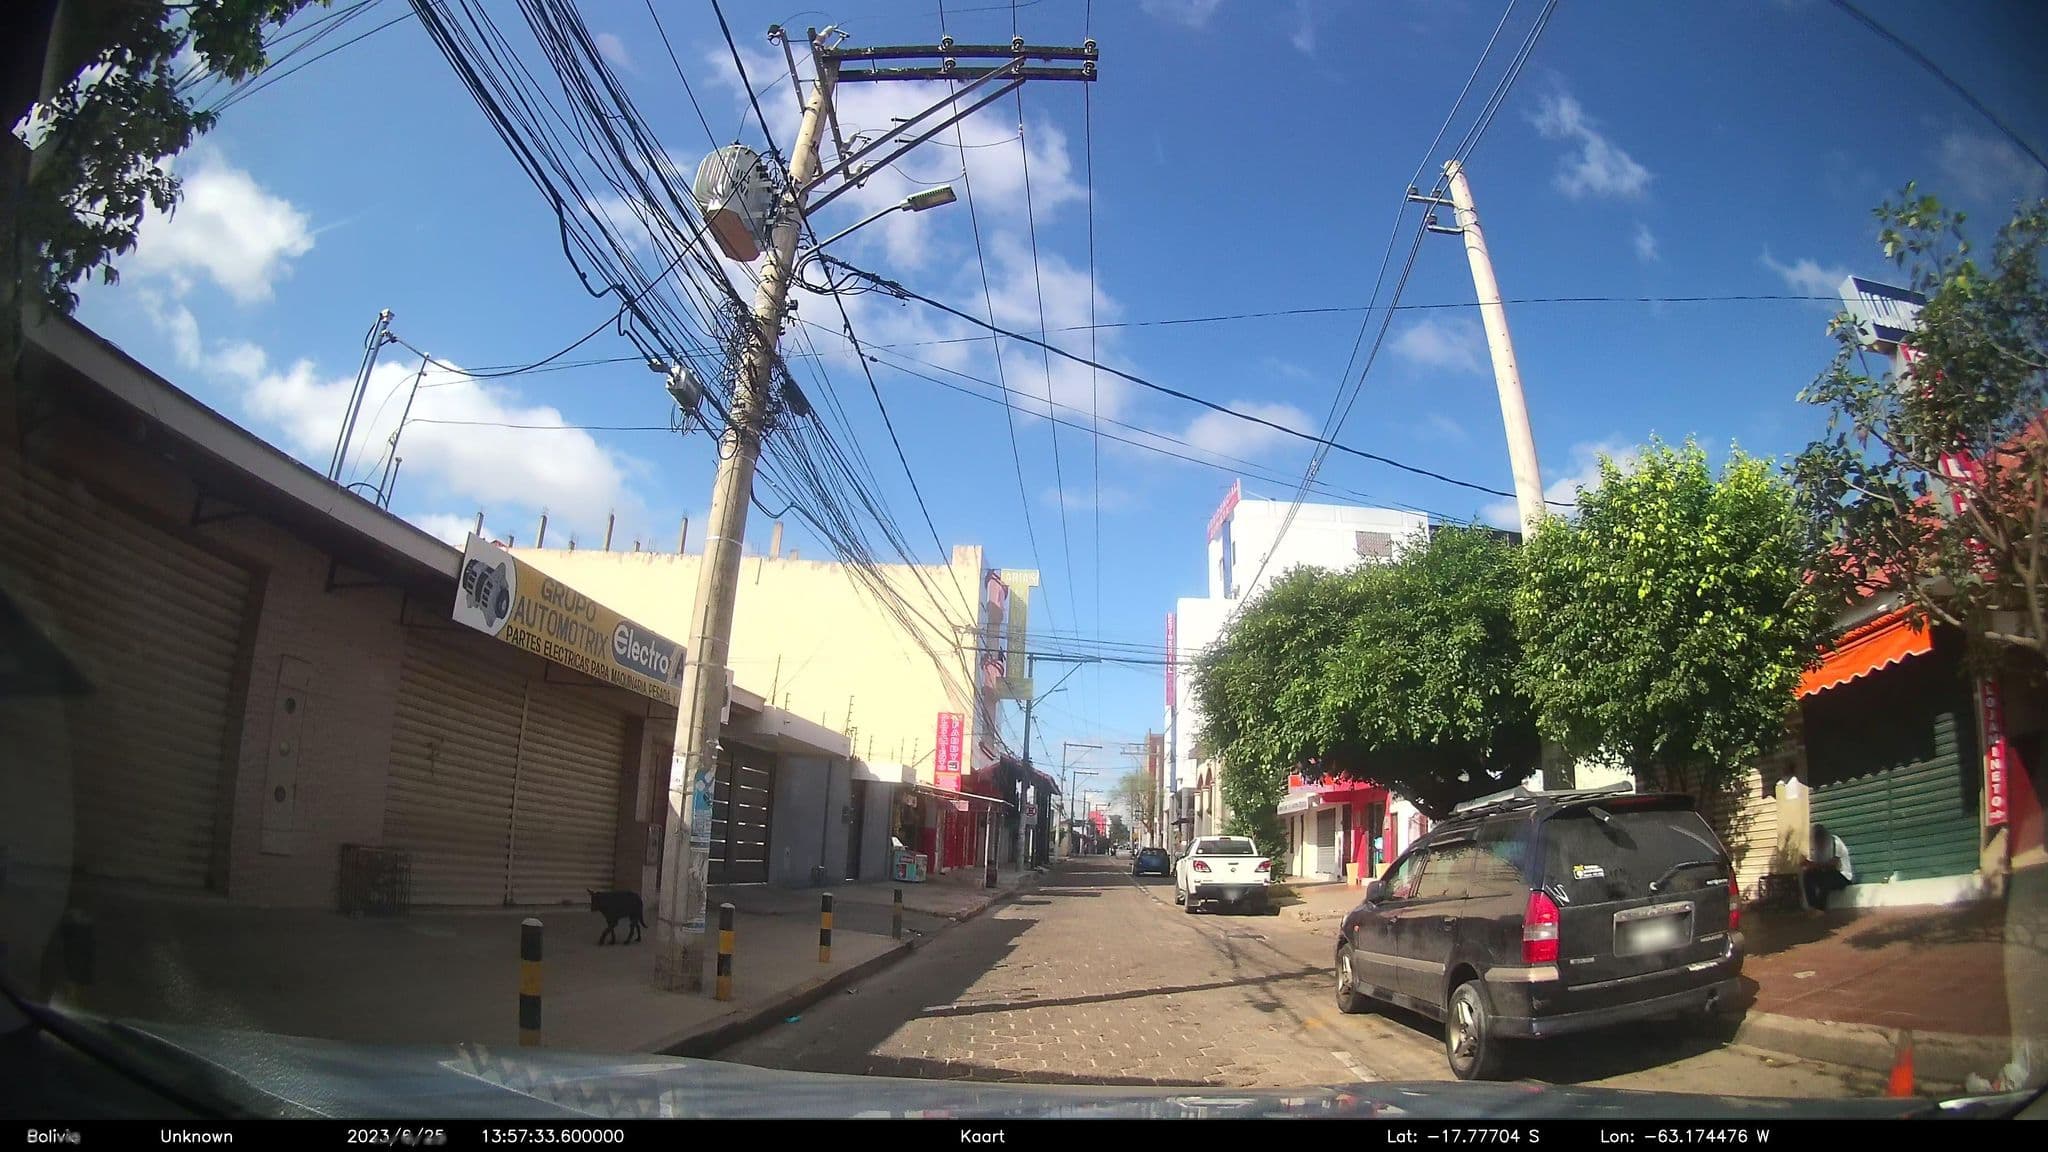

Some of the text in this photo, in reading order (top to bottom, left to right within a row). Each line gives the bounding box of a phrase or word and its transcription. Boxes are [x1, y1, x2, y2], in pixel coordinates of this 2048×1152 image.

[541, 579, 597, 622] GRUPO
[506, 625, 541, 653] PARTES
[544, 641, 590, 673] ELECTRICAS
[590, 660, 609, 680] PARA
[513, 595, 609, 659] AUTOMOTRIX
[613, 624, 669, 674] Electro
